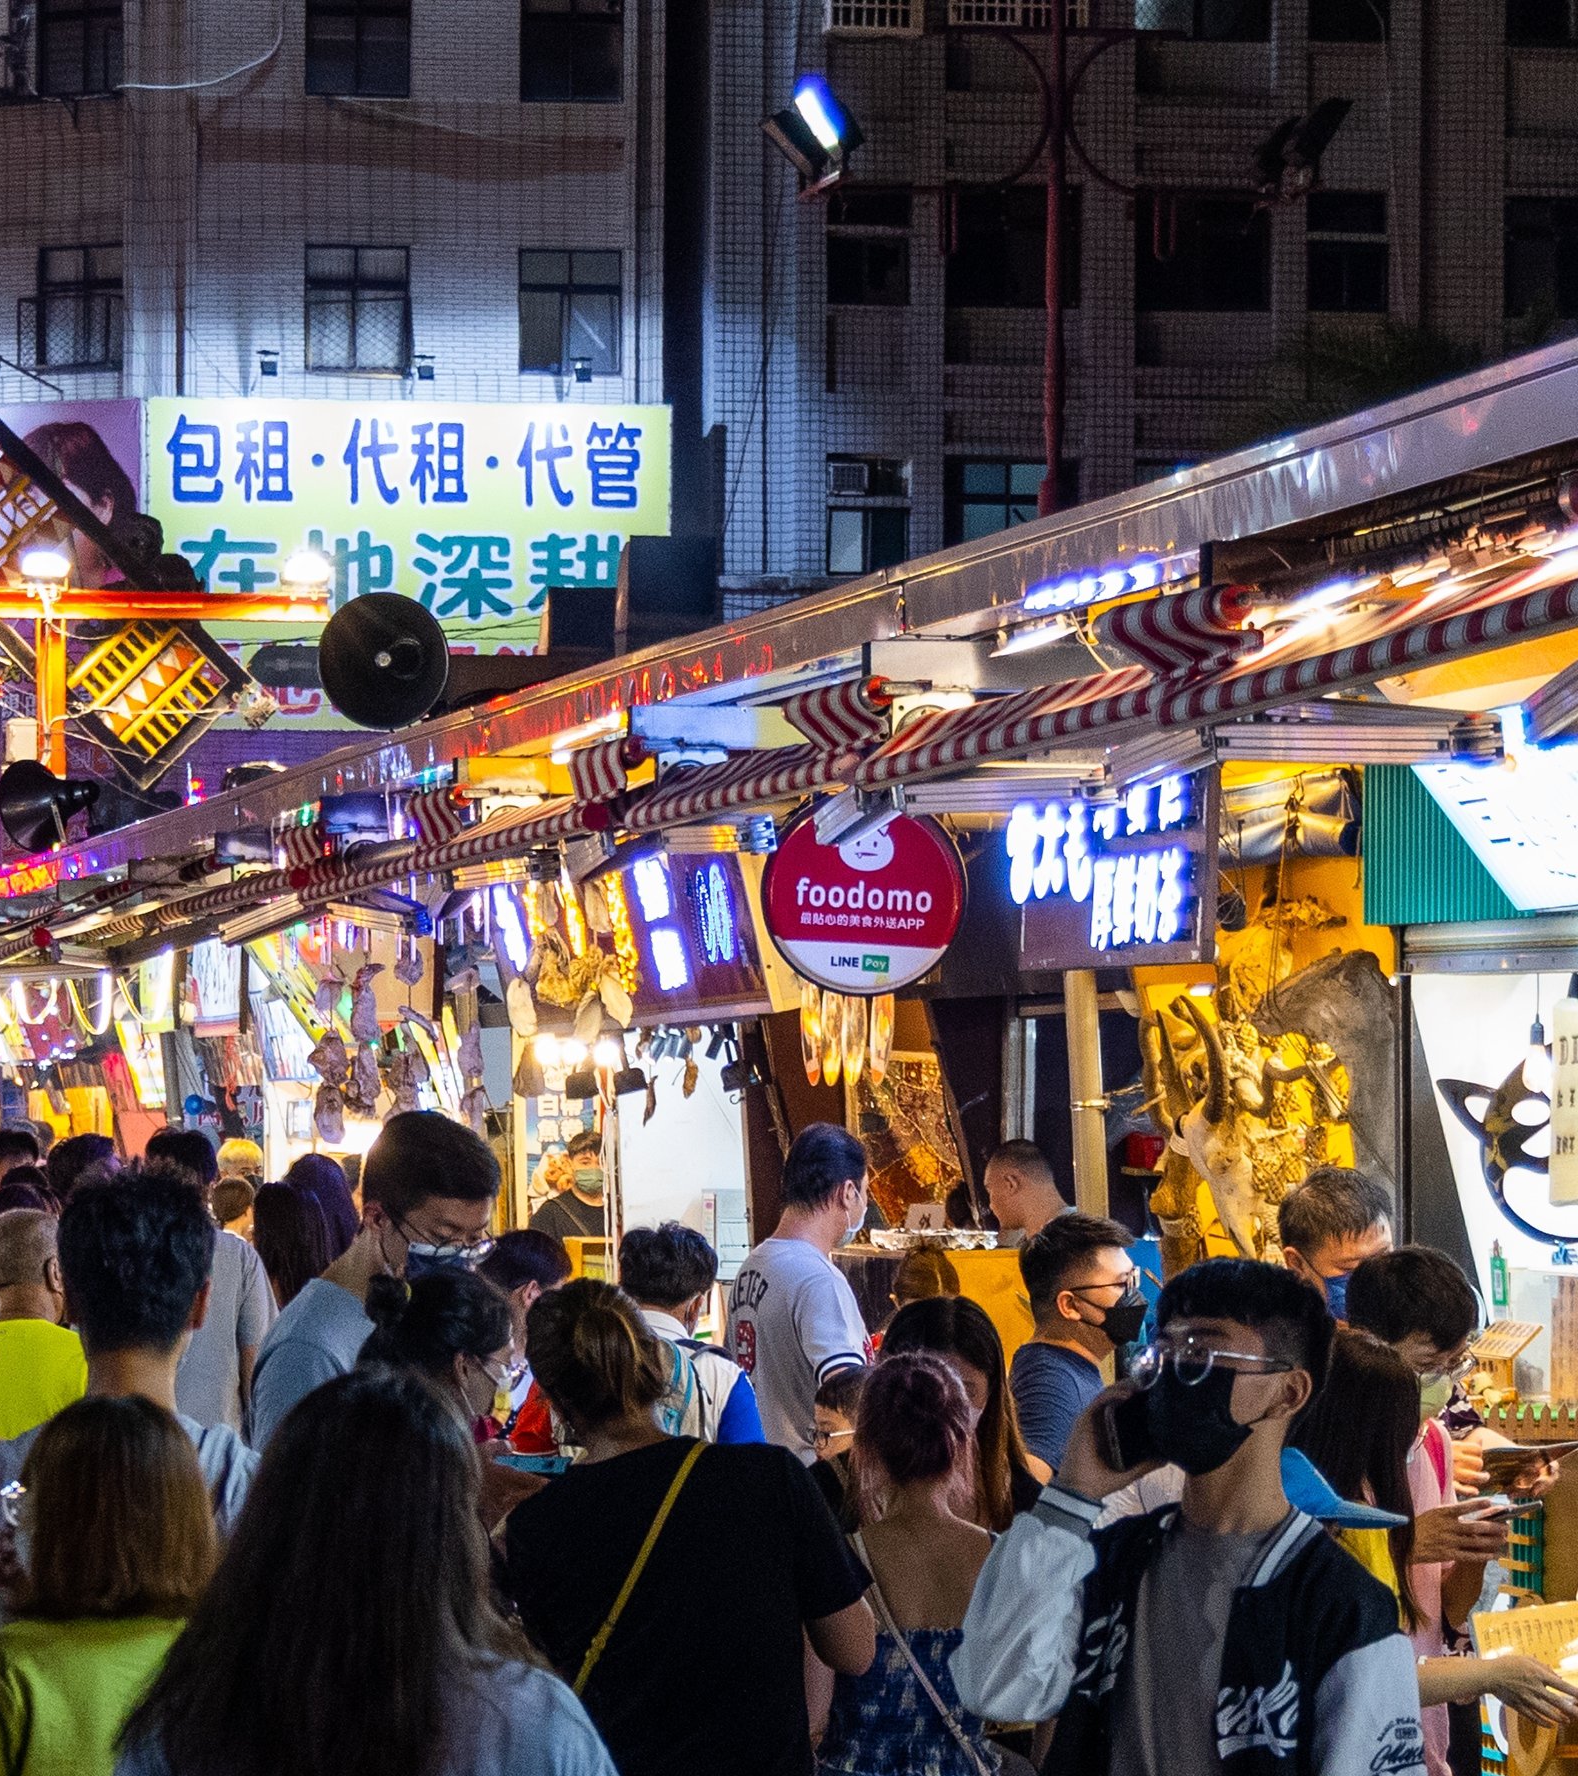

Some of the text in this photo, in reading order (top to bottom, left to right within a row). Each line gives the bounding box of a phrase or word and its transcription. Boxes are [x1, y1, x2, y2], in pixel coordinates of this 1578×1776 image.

[796, 876, 933, 914] foodomo
[800, 910, 925, 931] 最貼心的美食外送APP
[830, 955, 888, 971] LINE Pay
